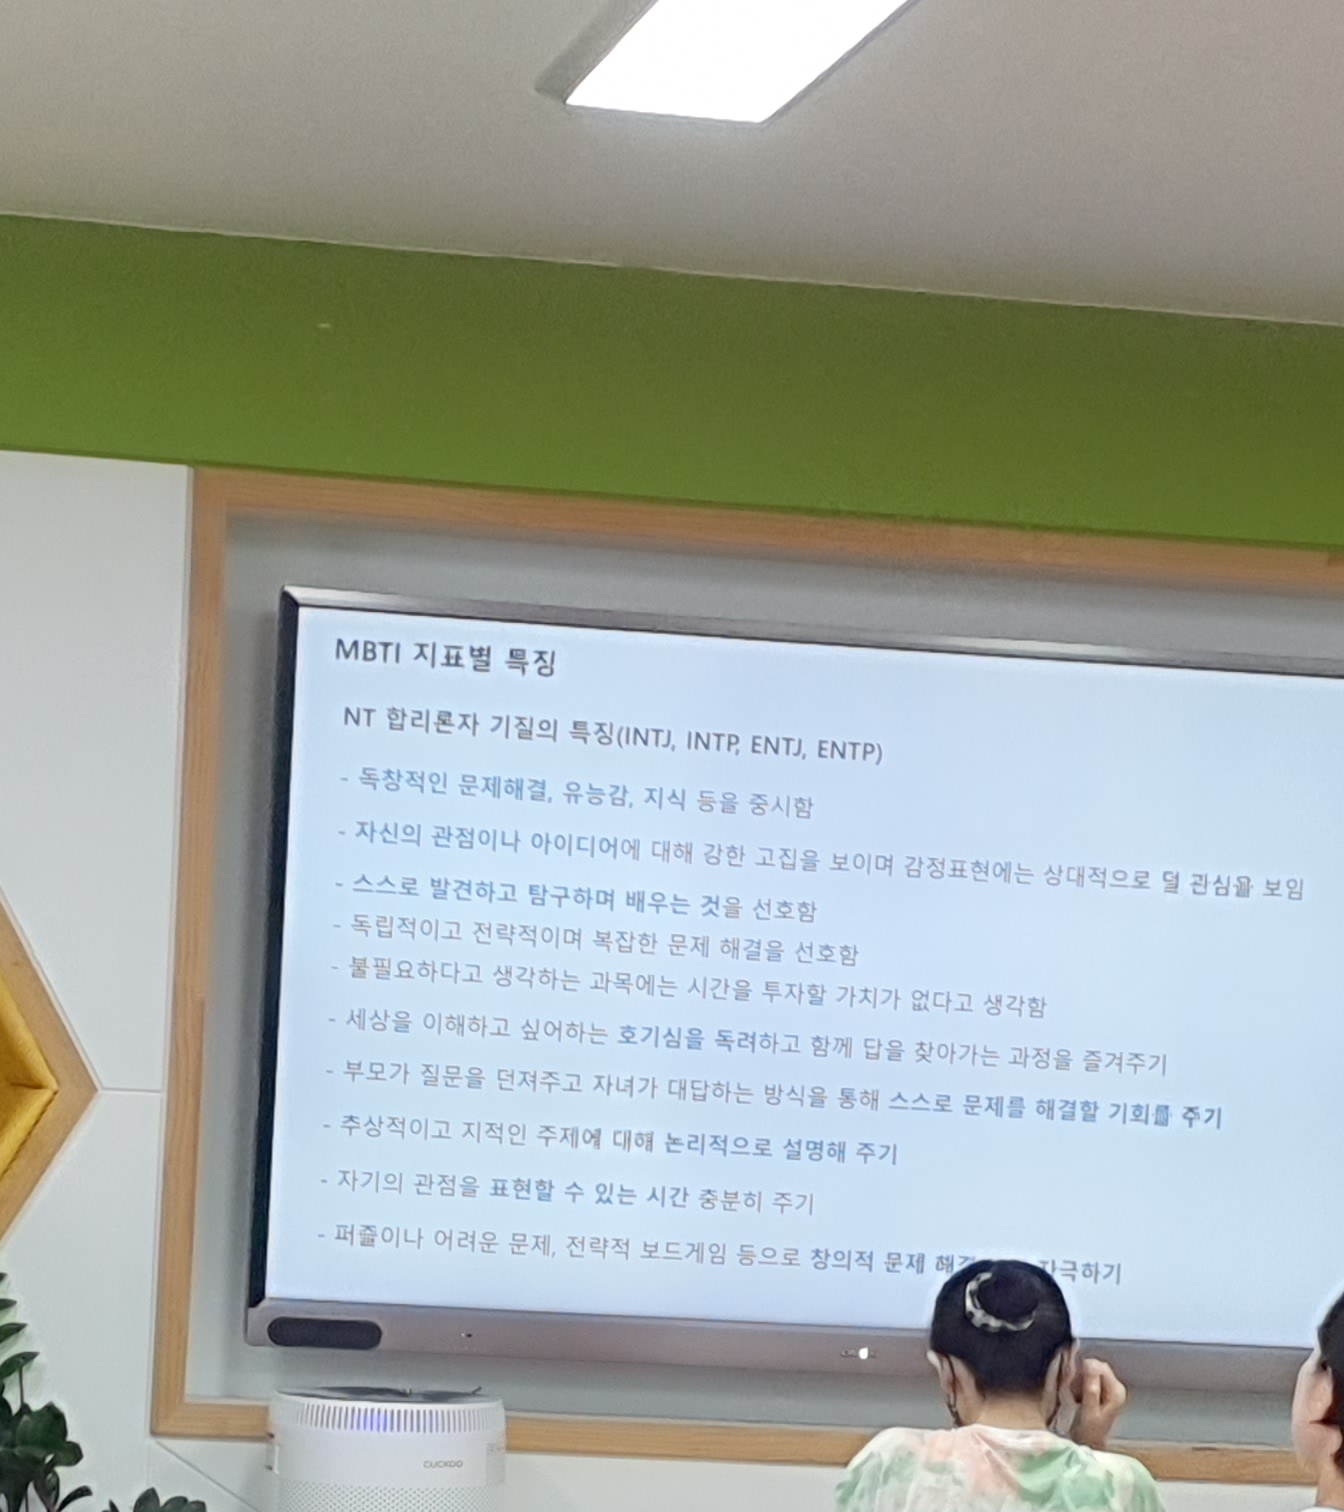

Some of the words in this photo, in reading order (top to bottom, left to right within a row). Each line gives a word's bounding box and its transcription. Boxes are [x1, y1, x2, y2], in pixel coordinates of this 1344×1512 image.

[335, 637, 402, 665] MBTI
[412, 641, 492, 673] 지표별
[504, 647, 556, 678] 특징
[343, 706, 377, 728] NT
[386, 706, 480, 738] 합리론자
[489, 714, 558, 743] 기질의
[568, 719, 676, 753] 특징(INTJ,
[686, 730, 741, 757] INTP,
[750, 734, 807, 761] ENTJ,
[817, 739, 883, 766] ENTP)
[358, 767, 448, 795] 독창적인
[458, 773, 553, 804] 문제해결,
[562, 781, 634, 809] 유능감,
[643, 786, 686, 812] 지식
[696, 790, 739, 815] 등을
[749, 793, 814, 820] 중시함
[355, 820, 422, 848] 자신의
[431, 825, 521, 854] 관점이나
[530, 832, 641, 862] 아이디어에
[651, 840, 694, 865] 대해
[703, 843, 746, 868] 강한
[754, 847, 821, 873] 고집을
[829, 853, 894, 877] 보이며
[904, 855, 1035, 885] 감정표현에는
[1043, 864, 1151, 890] 상대적으로
[1262, 878, 1304, 901] 보임
[352, 873, 420, 897] 스스로
[430, 877, 518, 904] 발견하고
[528, 884, 615, 912] 탐구하며
[625, 890, 691, 916] 배우는
[700, 895, 743, 919] 것을
[752, 898, 818, 924] 선호함
[350, 914, 463, 942] 독립적이고
[473, 921, 582, 951] 전략적이며
[592, 929, 658, 955] 복잡한
[667, 933, 710, 959] 문제
[720, 937, 785, 963] 해결을
[795, 941, 860, 967] 선호함
[348, 956, 483, 985] 불필요하다고
[492, 965, 581, 993] 생각하는
[589, 971, 678, 998] 과목에는
[687, 976, 753, 1002] 시간을
[761, 980, 827, 1007] 투자할
[836, 985, 902, 1011] 가치가
[911, 989, 974, 1014] 없다고
[983, 994, 1048, 1019] 생각함
[346, 1007, 413, 1034] 세상을
[423, 1012, 511, 1039] 이해하고
[520, 1018, 609, 1046] 싶어하는
[617, 1024, 705, 1051] 호기심을
[714, 1029, 801, 1055] 독려하고
[810, 1034, 853, 1059] 함께
[863, 1037, 905, 1062] 답을
[915, 1040, 1001, 1068] 찾아가는
[1007, 1046, 1073, 1071] 과정을
[1082, 1049, 1167, 1077] 즐겨주기
[343, 1060, 410, 1085] 부모가
[421, 1063, 486, 1090] 질문을
[497, 1068, 583, 1094] 던져주고
[592, 1074, 659, 1100] 자녀가
[667, 1078, 755, 1105] 대답하는
[764, 1083, 828, 1109] 방식을
[837, 1087, 880, 1112] 통해
[888, 1091, 953, 1113] 스스로
[962, 1094, 1026, 1119] 문제를
[1035, 1098, 1100, 1123] 해결할
[1181, 1105, 1222, 1130] 주기
[340, 1114, 452, 1141] 추상적이고
[461, 1121, 527, 1147] 지적인
[612, 1129, 655, 1153] 대해
[664, 1132, 773, 1158] 논리적으로
[782, 1138, 847, 1164] 설명해
[855, 1142, 898, 1166] 주기
[337, 1169, 403, 1195] 자기의
[413, 1173, 480, 1198] 관점을
[489, 1177, 556, 1203] 표현할
[563, 1181, 585, 1204] 수
[594, 1182, 637, 1206] 있는
[646, 1185, 690, 1209] 시간
[698, 1188, 762, 1214] 충분히
[772, 1191, 814, 1216] 주기
[334, 1223, 424, 1250] 퍼즐이나
[434, 1229, 499, 1254] 어려운
[508, 1232, 556, 1258] 문제,
[566, 1235, 630, 1261] 전략적
[640, 1241, 726, 1266] 보드게임
[736, 1244, 801, 1267] 등으로
[810, 1247, 874, 1273] 창의적
[883, 1251, 926, 1275] 문제
[422, 1459, 464, 1469] CUCKOO
